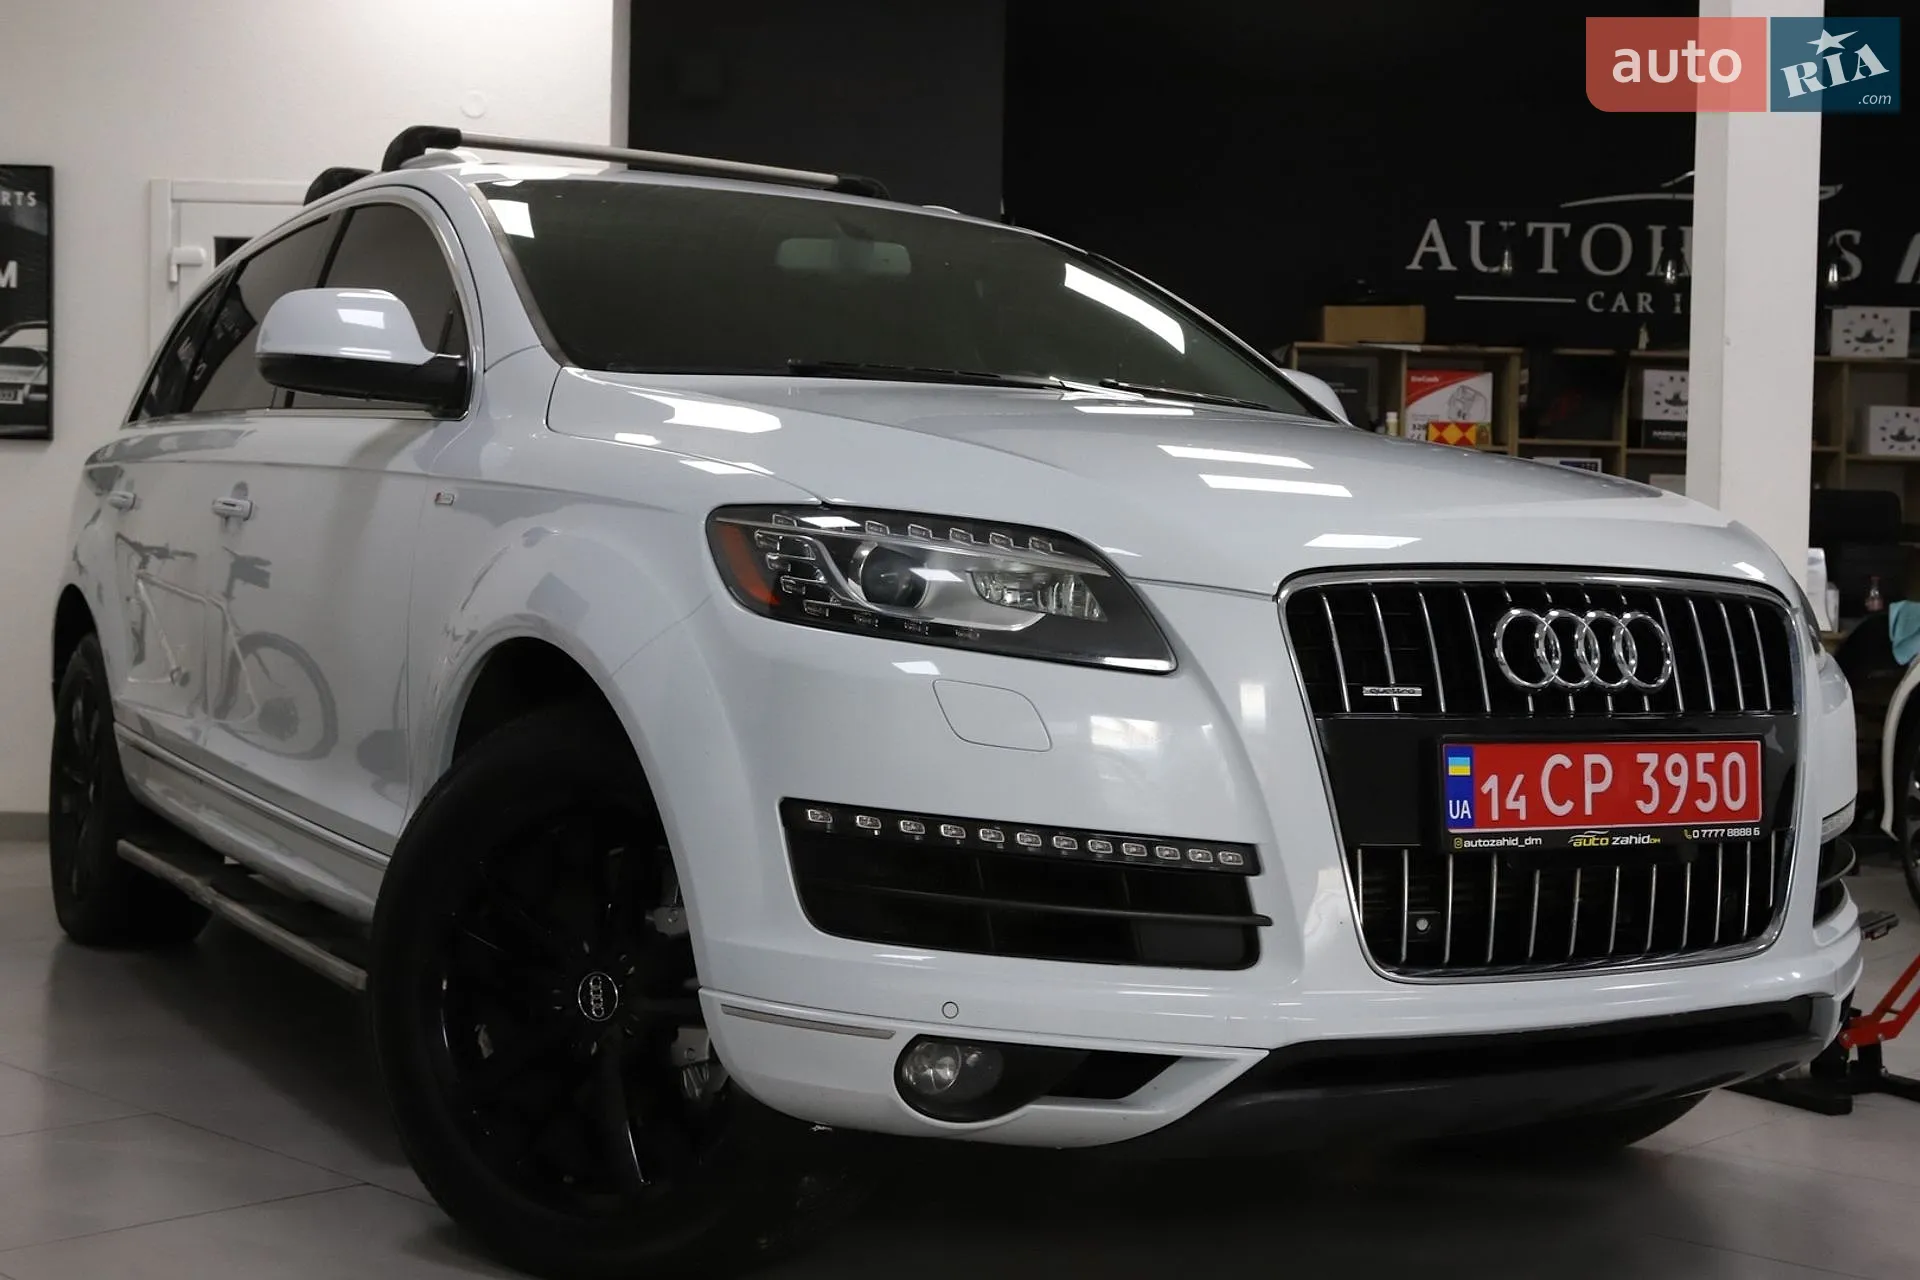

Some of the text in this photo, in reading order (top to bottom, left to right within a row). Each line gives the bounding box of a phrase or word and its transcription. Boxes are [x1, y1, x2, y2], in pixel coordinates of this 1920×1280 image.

[1586, 290, 1655, 313] CAR
[1481, 752, 1747, 821] 14 CP 3950
[1449, 800, 1472, 820] UA
[1463, 836, 1542, 848] autozahid_dm
